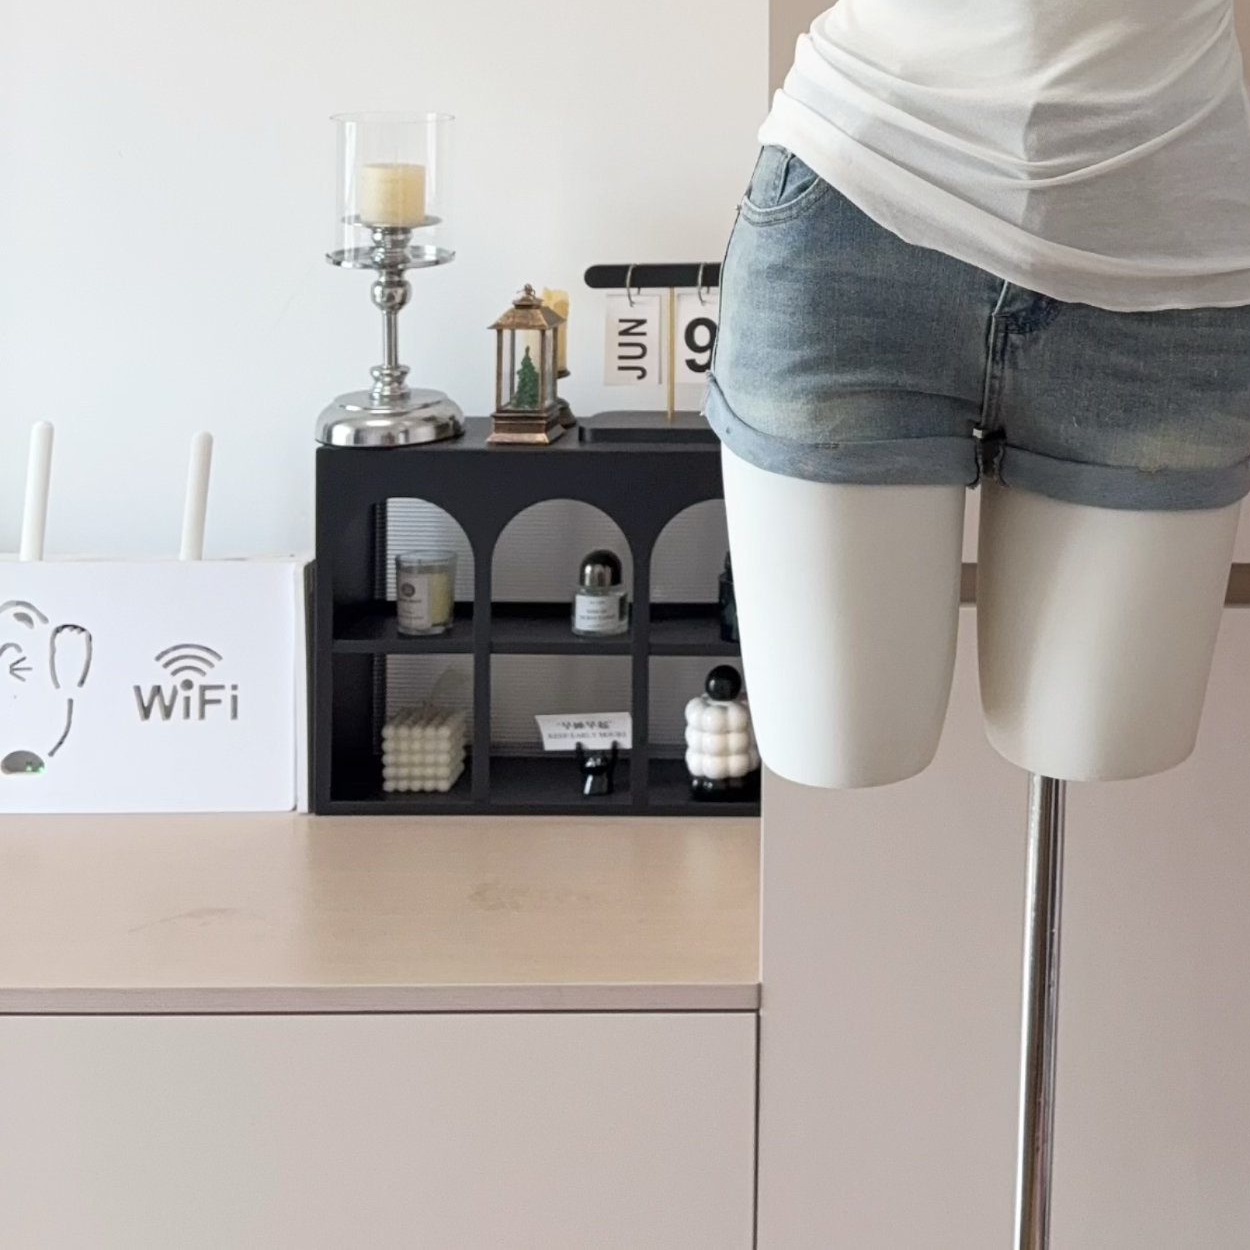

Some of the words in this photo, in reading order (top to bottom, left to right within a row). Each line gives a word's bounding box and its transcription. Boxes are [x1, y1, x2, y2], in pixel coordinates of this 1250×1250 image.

[617, 318, 648, 381] JUN
[684, 316, 718, 373] 9
[132, 678, 239, 722] WiFi
